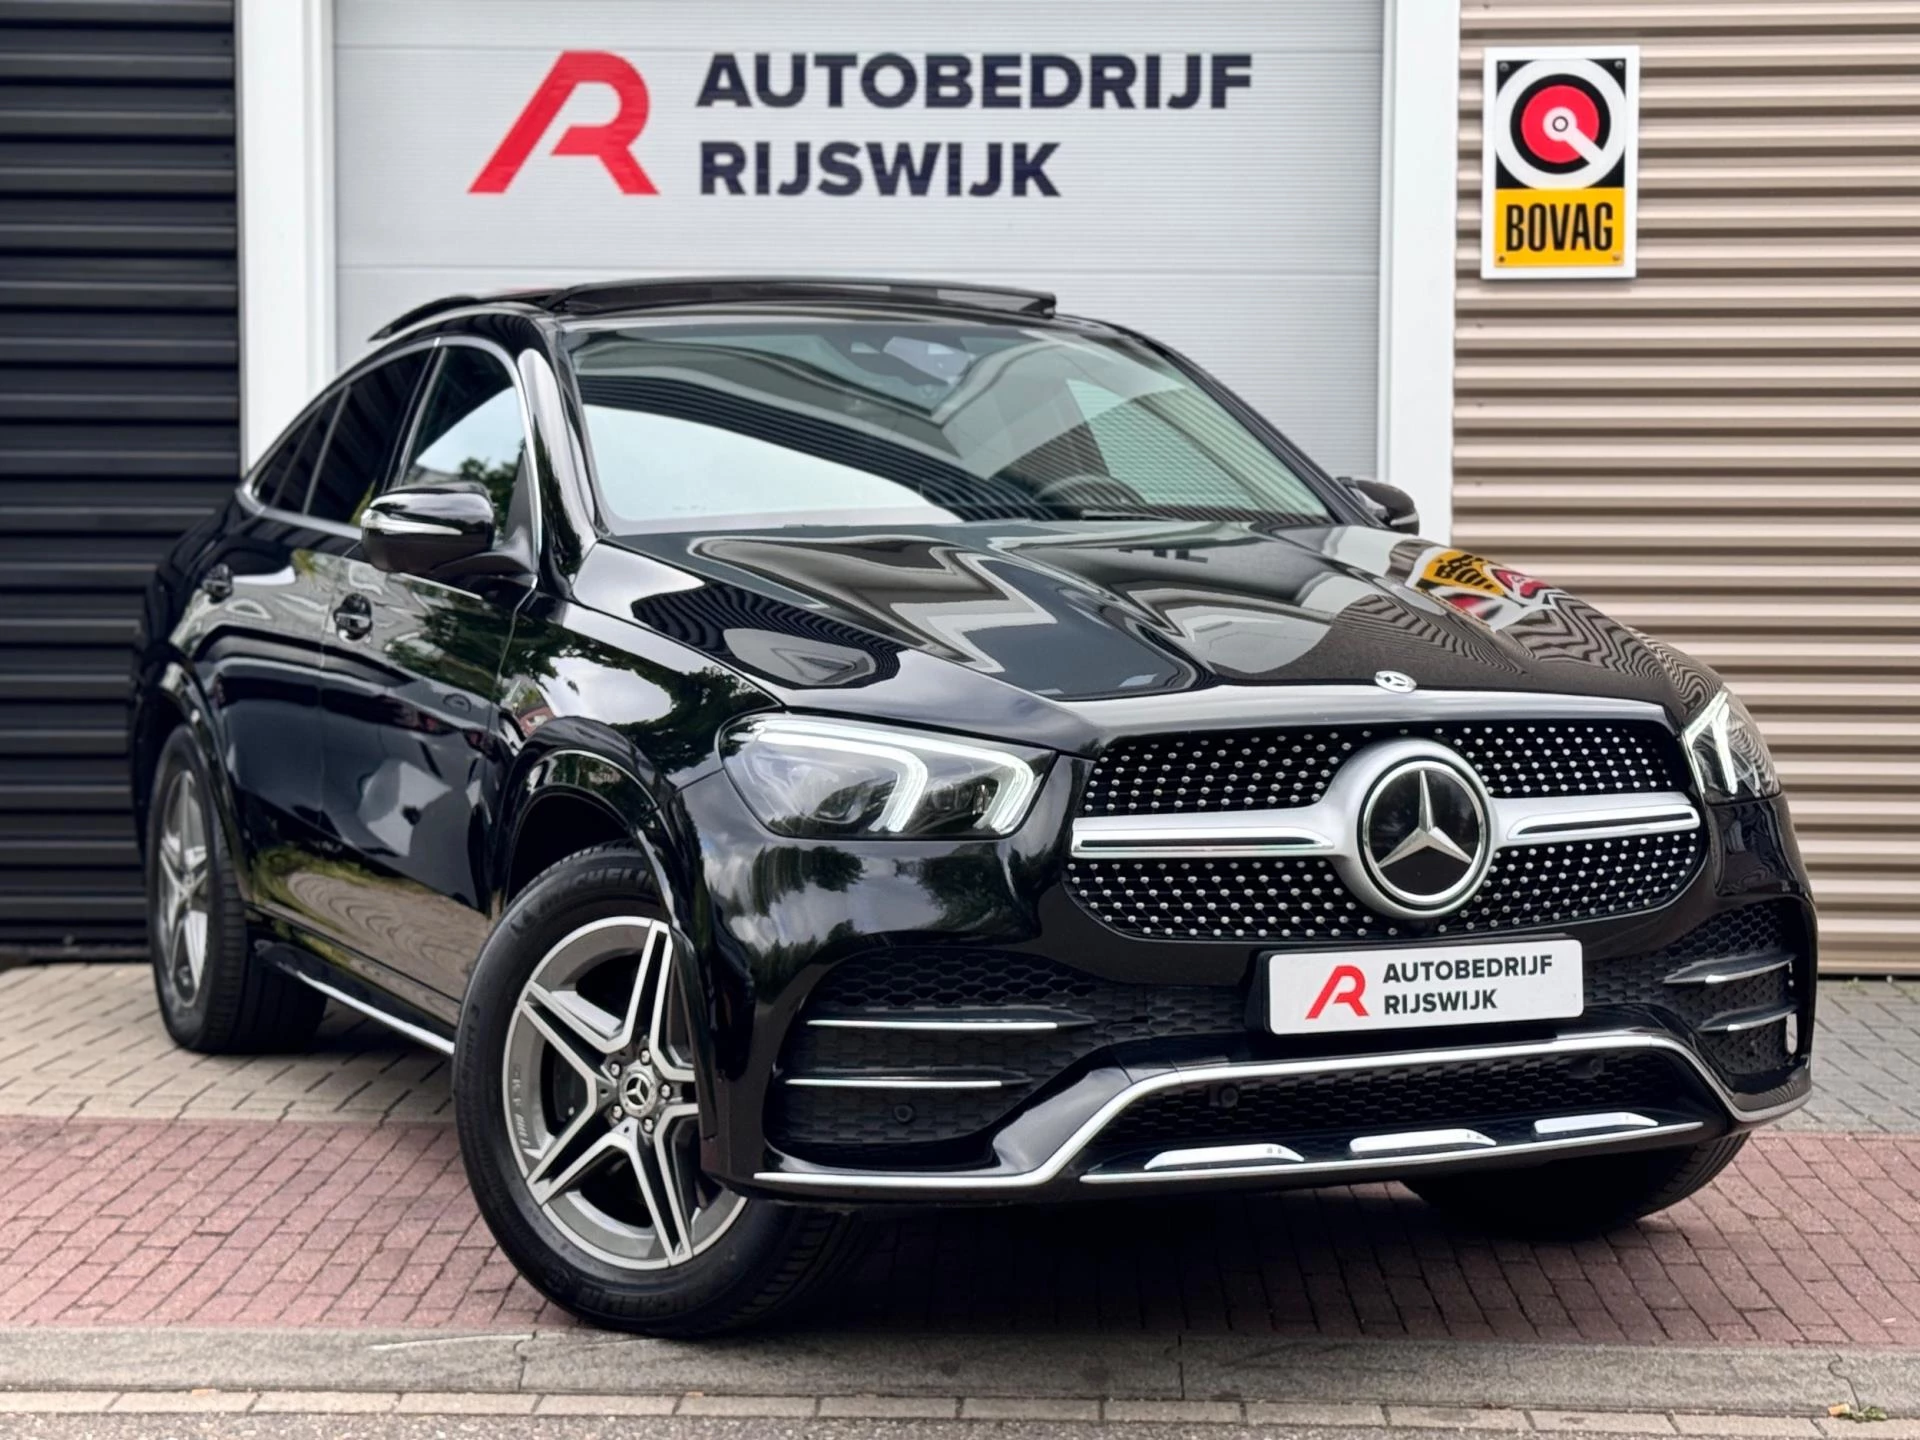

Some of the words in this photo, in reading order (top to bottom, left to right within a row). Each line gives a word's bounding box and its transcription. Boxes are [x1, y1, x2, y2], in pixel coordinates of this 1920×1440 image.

[697, 53, 1252, 110] AUTOBEDRIJF
[700, 141, 1060, 197] RIJSWIJK
[1506, 202, 1613, 252] BOVAG
[1383, 954, 1553, 983] AUTOBEDRIJF
[1383, 989, 1498, 1015] RIJSWIJK
